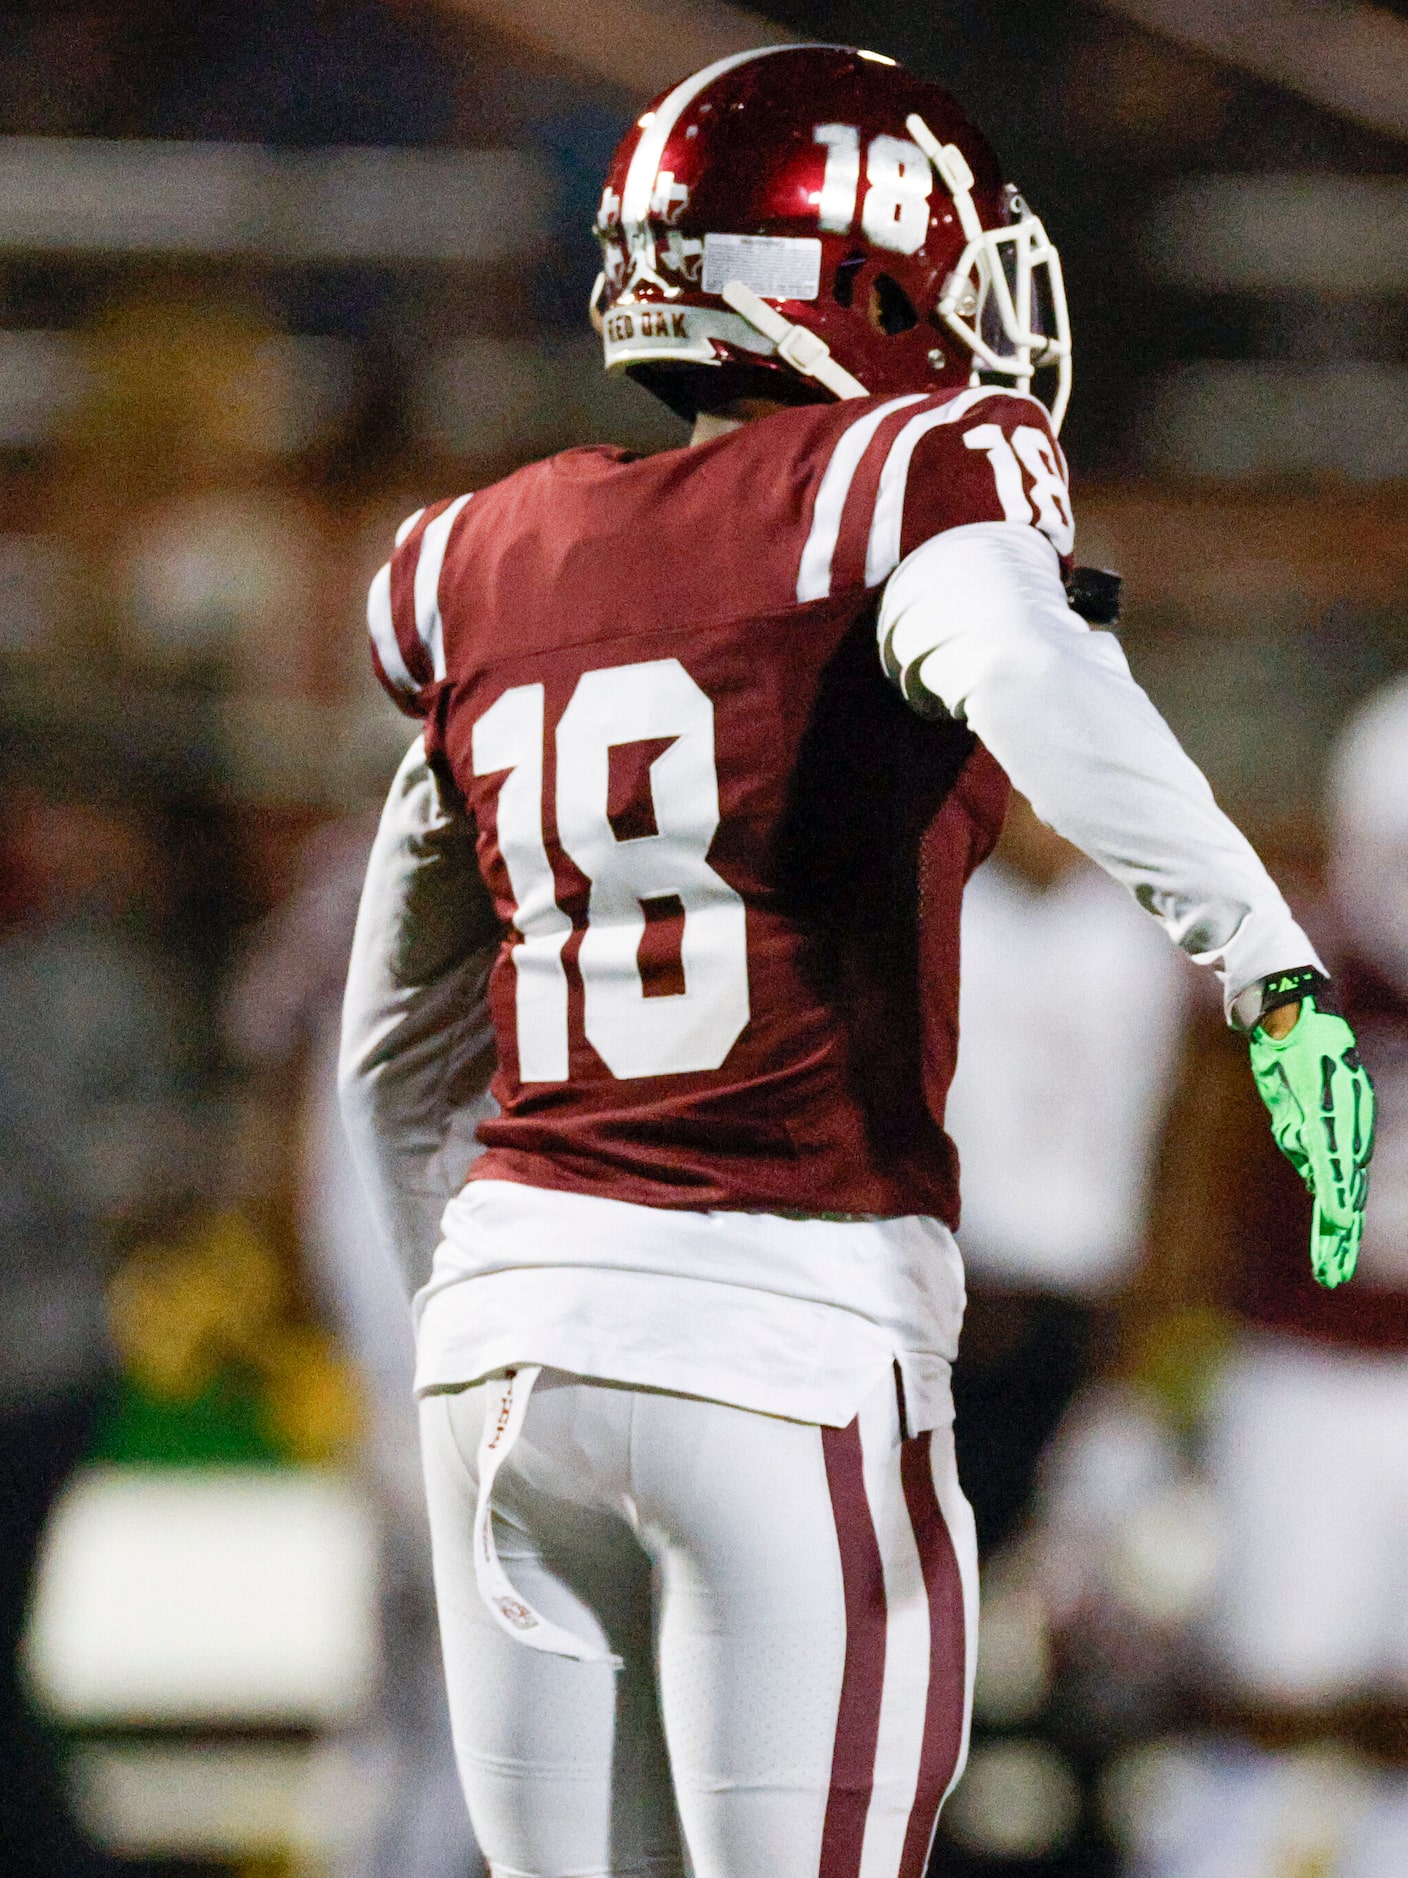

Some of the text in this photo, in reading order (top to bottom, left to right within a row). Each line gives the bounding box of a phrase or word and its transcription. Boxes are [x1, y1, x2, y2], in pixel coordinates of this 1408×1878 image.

[814, 122, 933, 256] 18
[641, 311, 687, 339] OAK
[962, 423, 1075, 557] 18
[471, 657, 751, 1083] 18
